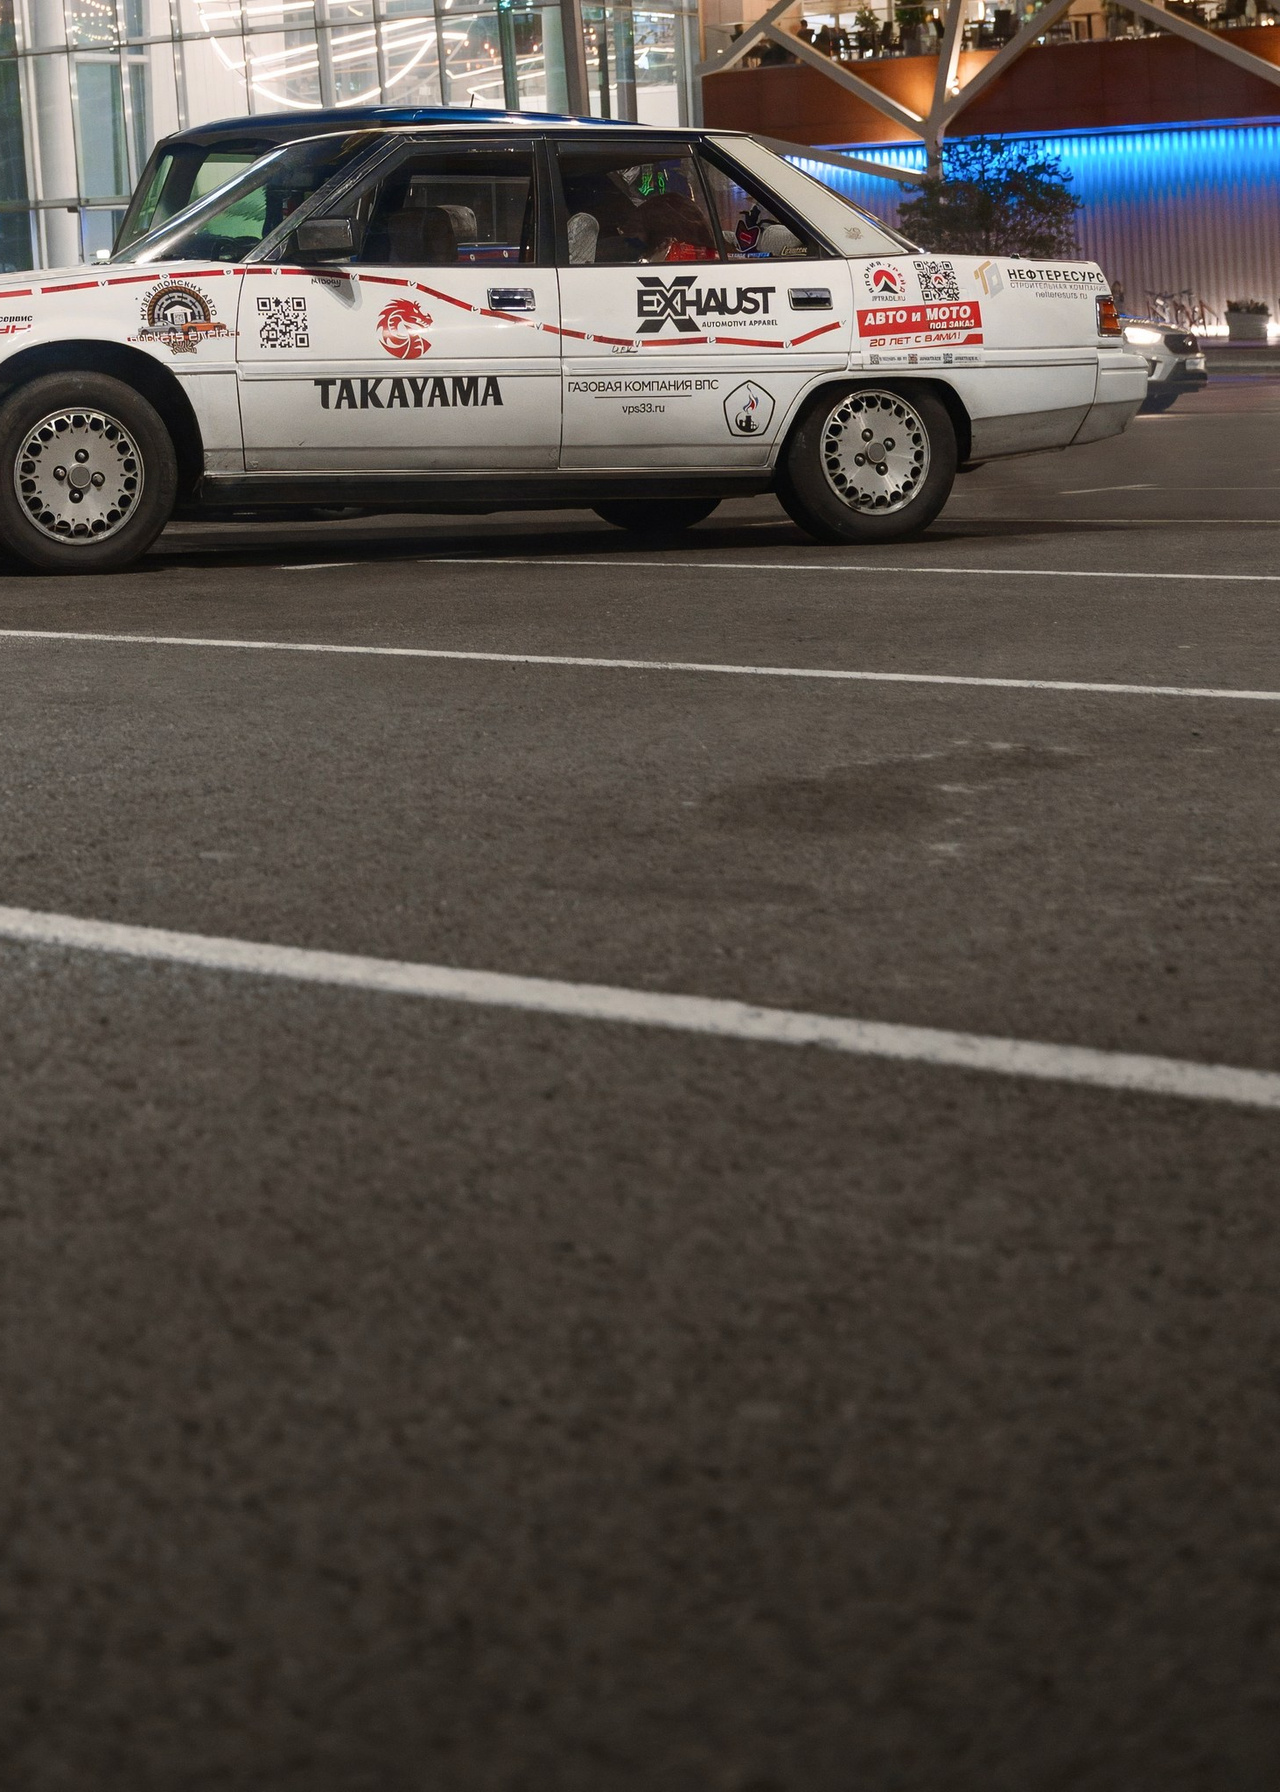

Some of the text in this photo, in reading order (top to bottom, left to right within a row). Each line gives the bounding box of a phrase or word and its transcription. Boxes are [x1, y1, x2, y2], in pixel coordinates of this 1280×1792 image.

[1007, 268, 1105, 283] НЕФТЕРЕСУРС
[1010, 282, 1068, 290] СТРОИТЕЛЬНАЯ
[140, 279, 218, 321] МУЗЕЙ ЯПОНСКИХ АВТО
[636, 275, 776, 334] EXHAUST
[864, 305, 971, 326] АВТО и МОТО
[701, 319, 779, 328] AUTOMOTIVE APPAREL
[929, 319, 975, 330] ПОД ЗАКАЗ
[869, 332, 961, 348] 20 ЛЕТ С ВАМИ!
[313, 376, 504, 410] TAKAYAMA
[567, 379, 719, 393] ГАЗОВАЯ КОМПАНИЯ ВПС
[622, 403, 666, 415] vps33.ru
